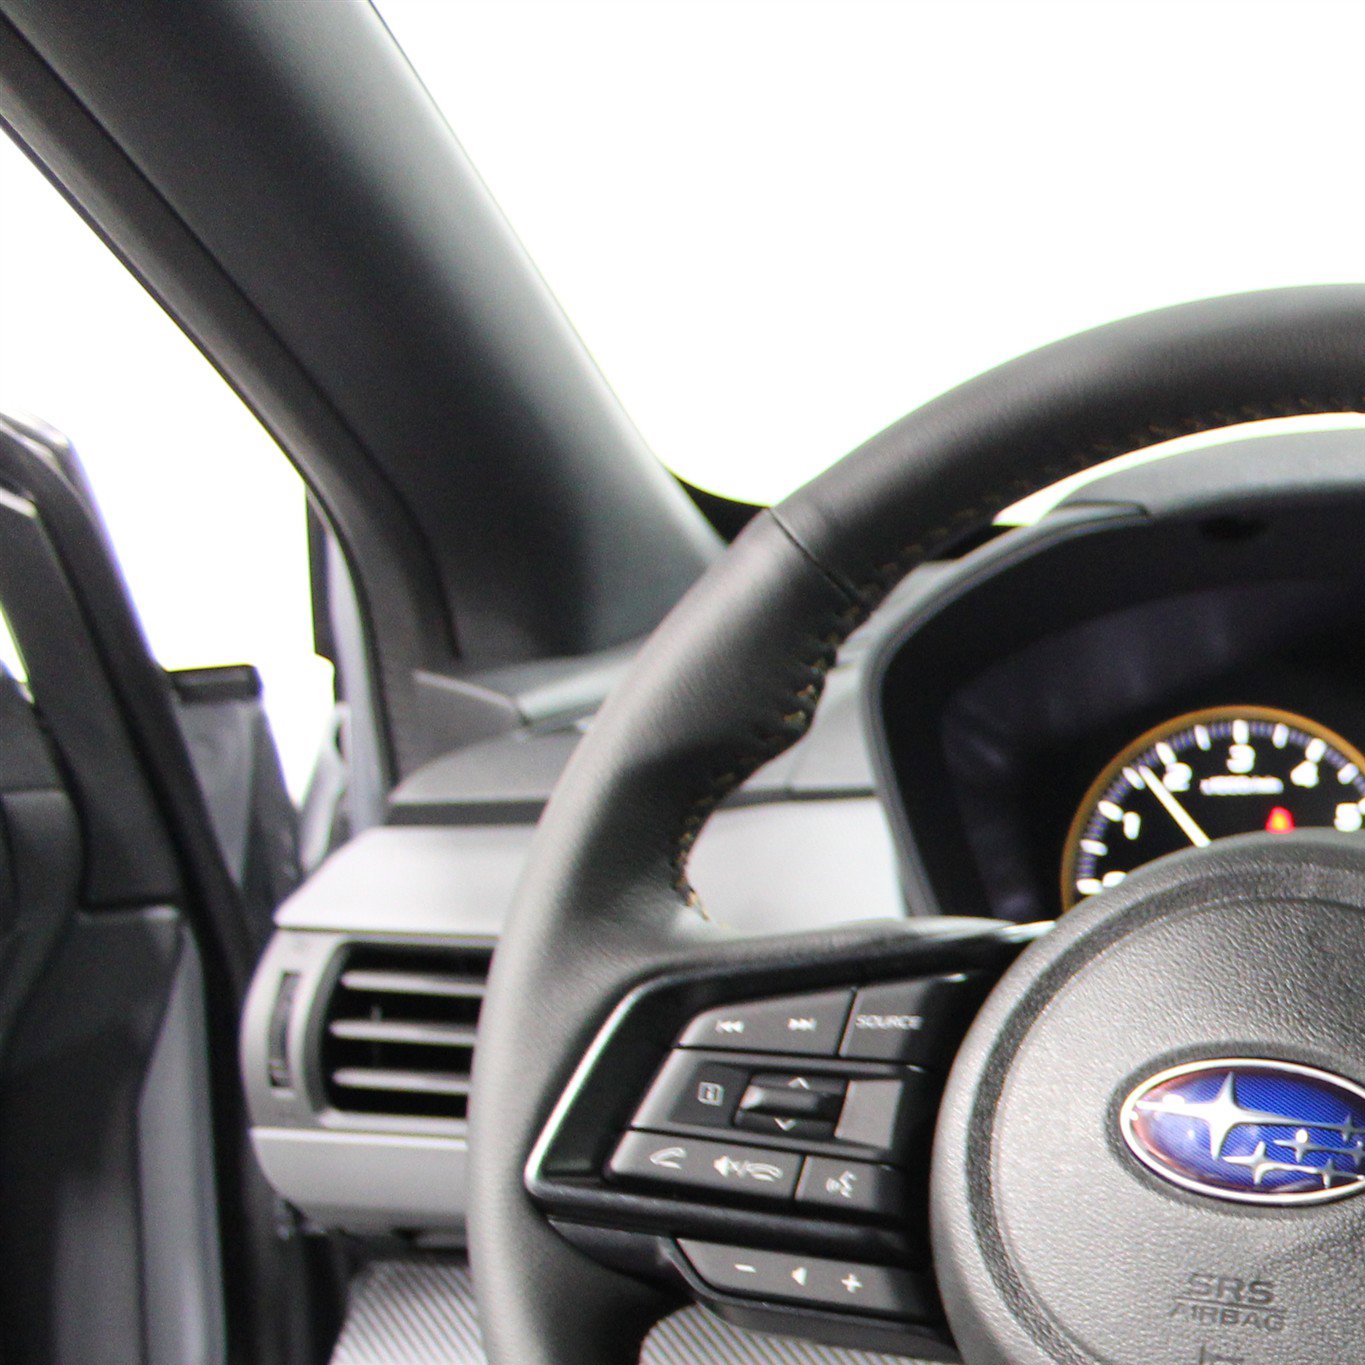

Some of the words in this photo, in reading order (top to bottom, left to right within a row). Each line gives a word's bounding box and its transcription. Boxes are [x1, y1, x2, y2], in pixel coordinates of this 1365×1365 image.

[1227, 744, 1256, 773] 3
[1163, 762, 1193, 792] 2
[856, 1013, 923, 1031] SOURCE
[1187, 1271, 1276, 1302] SRS
[1168, 1300, 1287, 1333] AIRBAG
